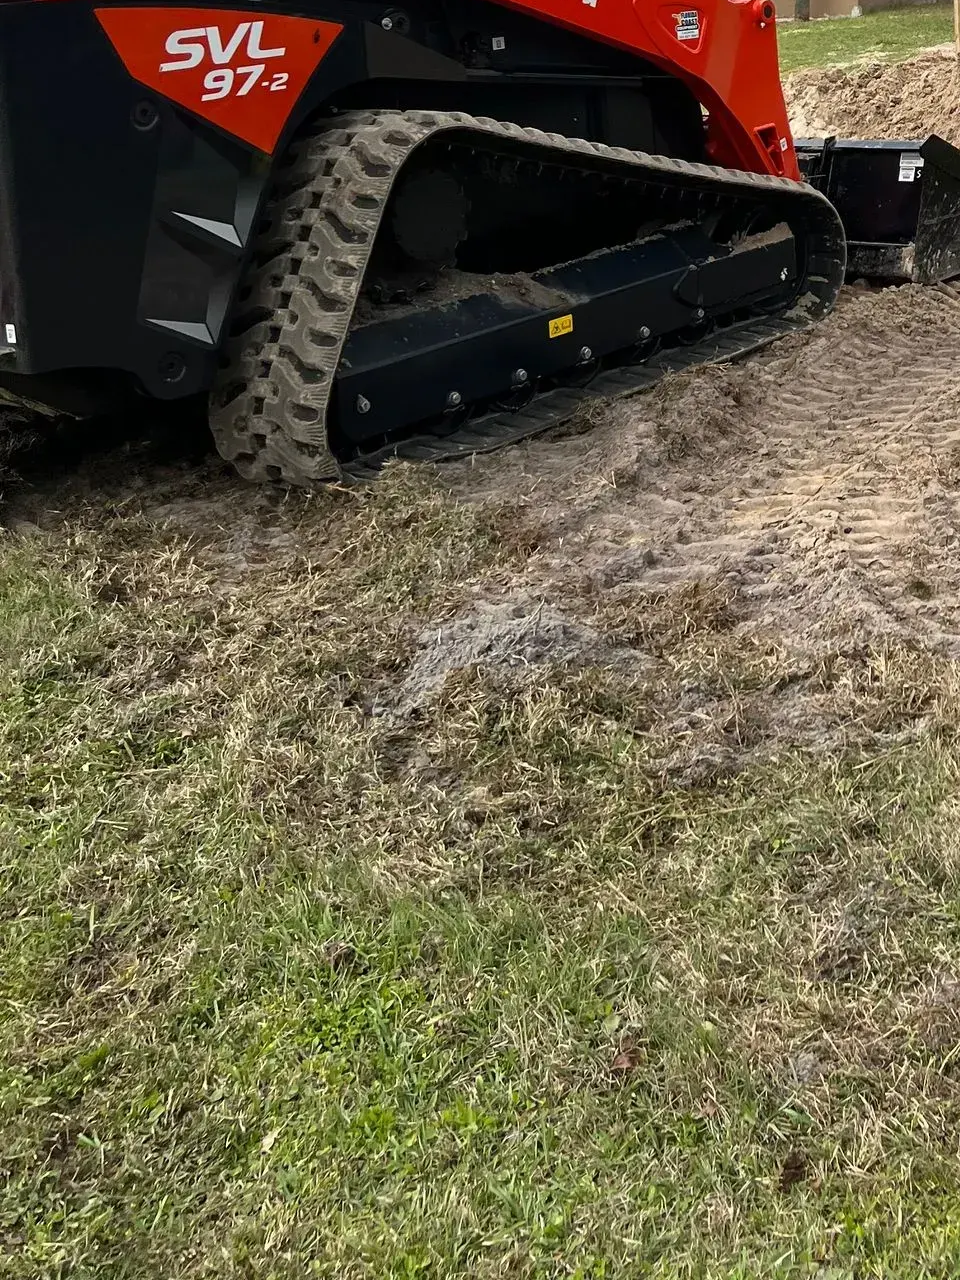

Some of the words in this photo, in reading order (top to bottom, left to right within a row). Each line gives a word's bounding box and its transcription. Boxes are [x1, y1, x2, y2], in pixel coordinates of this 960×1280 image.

[681, 18, 698, 27] COAST
[159, 20, 286, 72] SVL
[201, 64, 289, 101] 97-2
